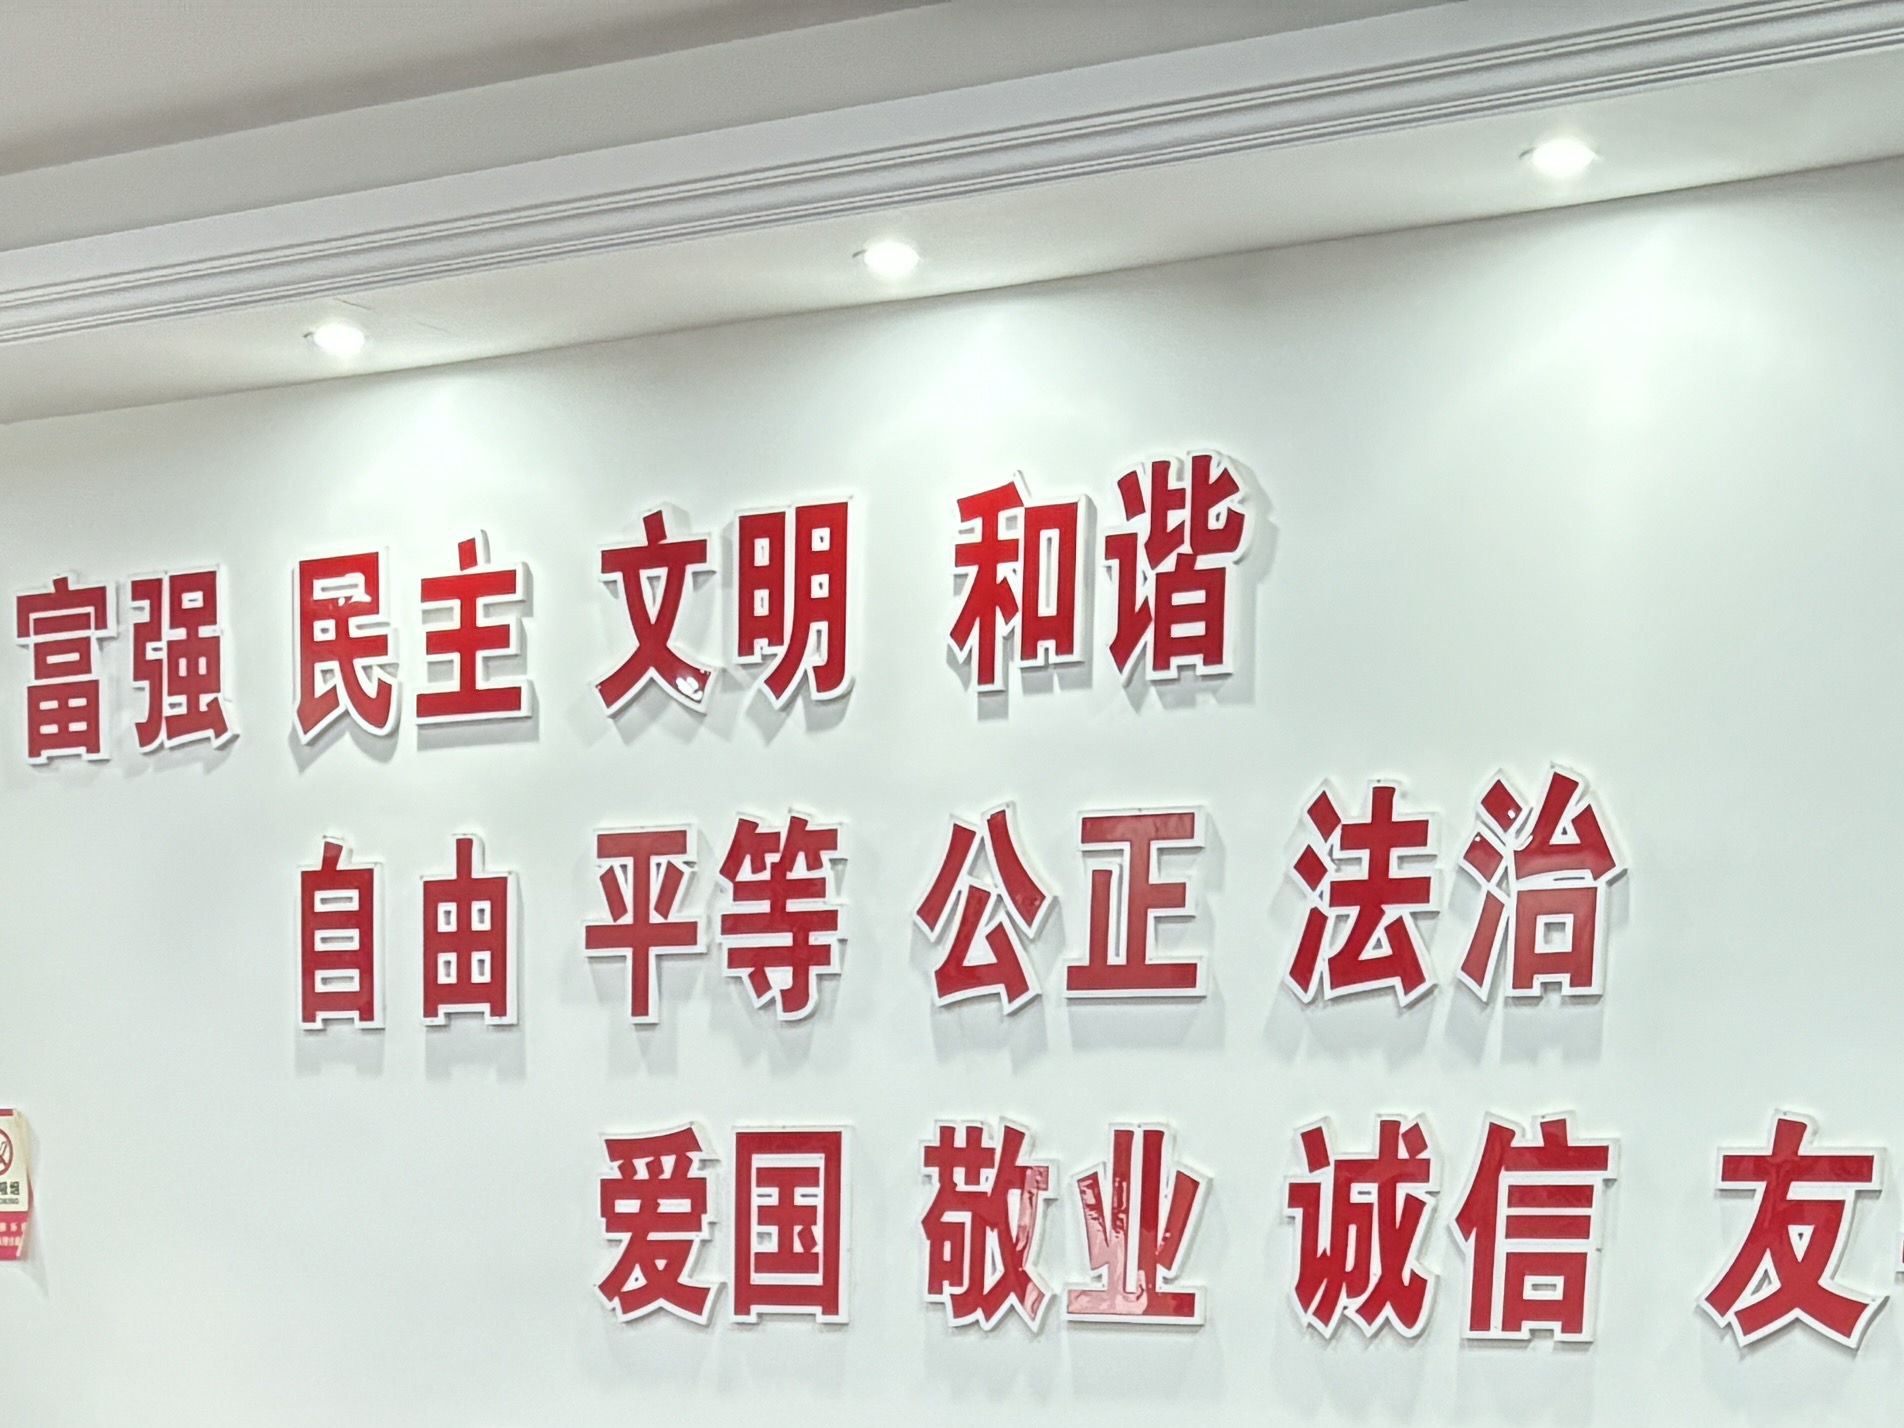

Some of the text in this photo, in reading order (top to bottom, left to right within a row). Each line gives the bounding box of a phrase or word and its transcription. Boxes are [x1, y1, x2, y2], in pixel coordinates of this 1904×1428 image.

[17, 454, 1246, 758] 富强 民主 文明 和谐
[300, 772, 1616, 1023] 自由 平等 公正 法治
[598, 1128, 844, 1318] 爱国
[922, 1126, 1202, 1319] 敬业
[1286, 1119, 1611, 1335] 诚信
